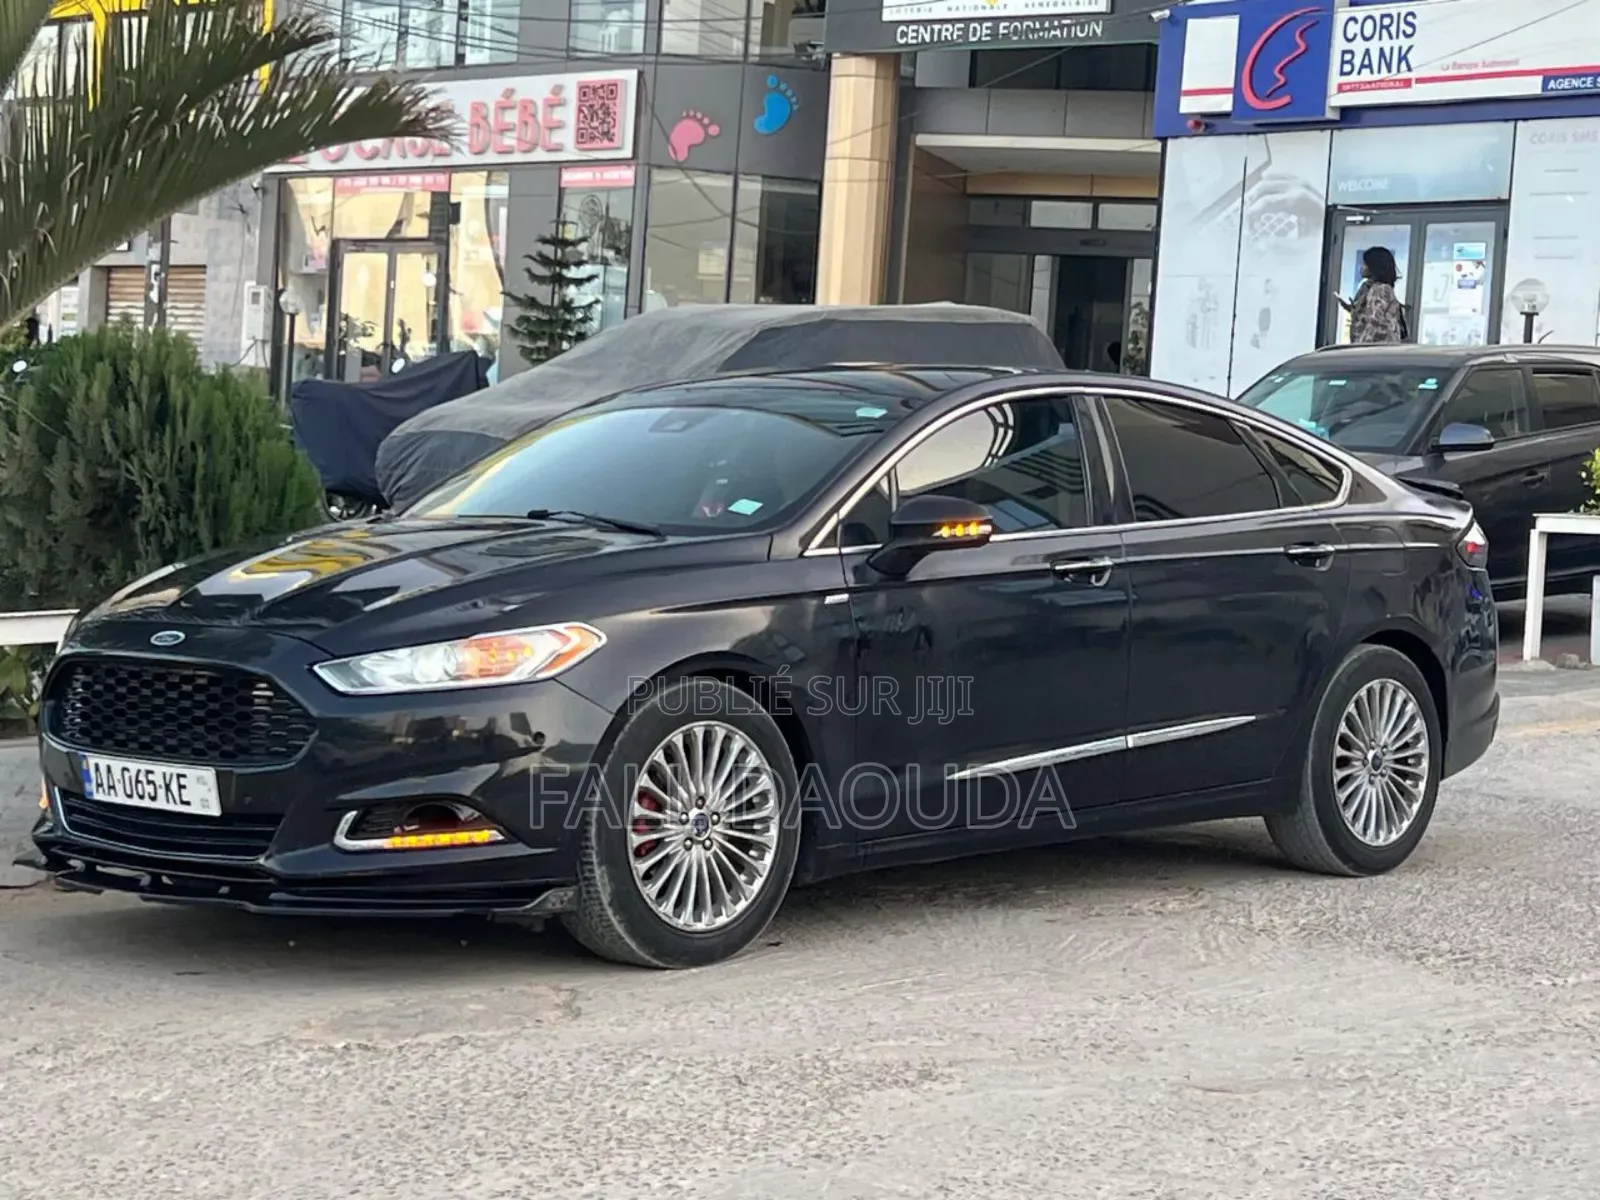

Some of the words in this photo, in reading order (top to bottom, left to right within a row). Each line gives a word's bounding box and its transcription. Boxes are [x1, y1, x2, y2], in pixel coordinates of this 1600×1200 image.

[896, 23, 965, 44] CENTRE
[969, 22, 993, 42] DE
[999, 19, 1103, 40] FORMATION
[1343, 11, 1417, 43] CORIS
[1339, 45, 1415, 77] BANK
[1548, 76, 1594, 90] AGENCE
[469, 84, 566, 155] BÉBÉ
